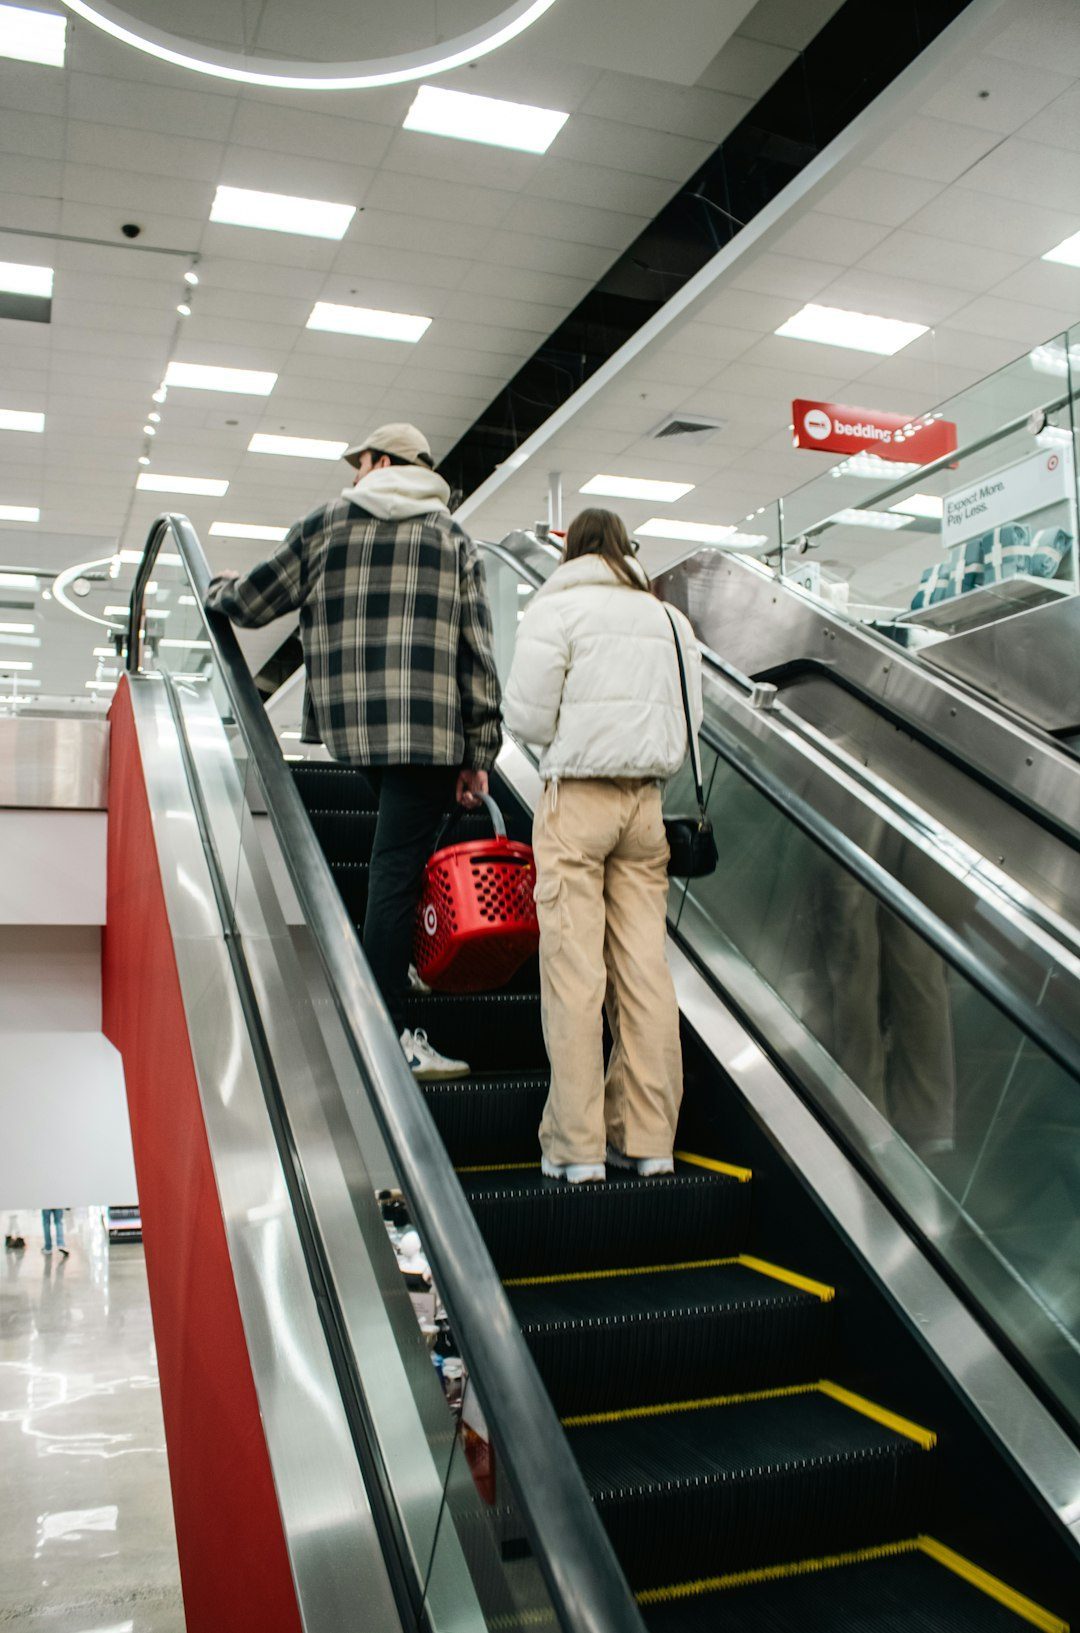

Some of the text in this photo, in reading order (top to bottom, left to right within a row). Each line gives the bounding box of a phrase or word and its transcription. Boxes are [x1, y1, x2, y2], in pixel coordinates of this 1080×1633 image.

[834, 419, 893, 443] bedding
[947, 492, 978, 514] Expect
[947, 512, 963, 527] Pay
